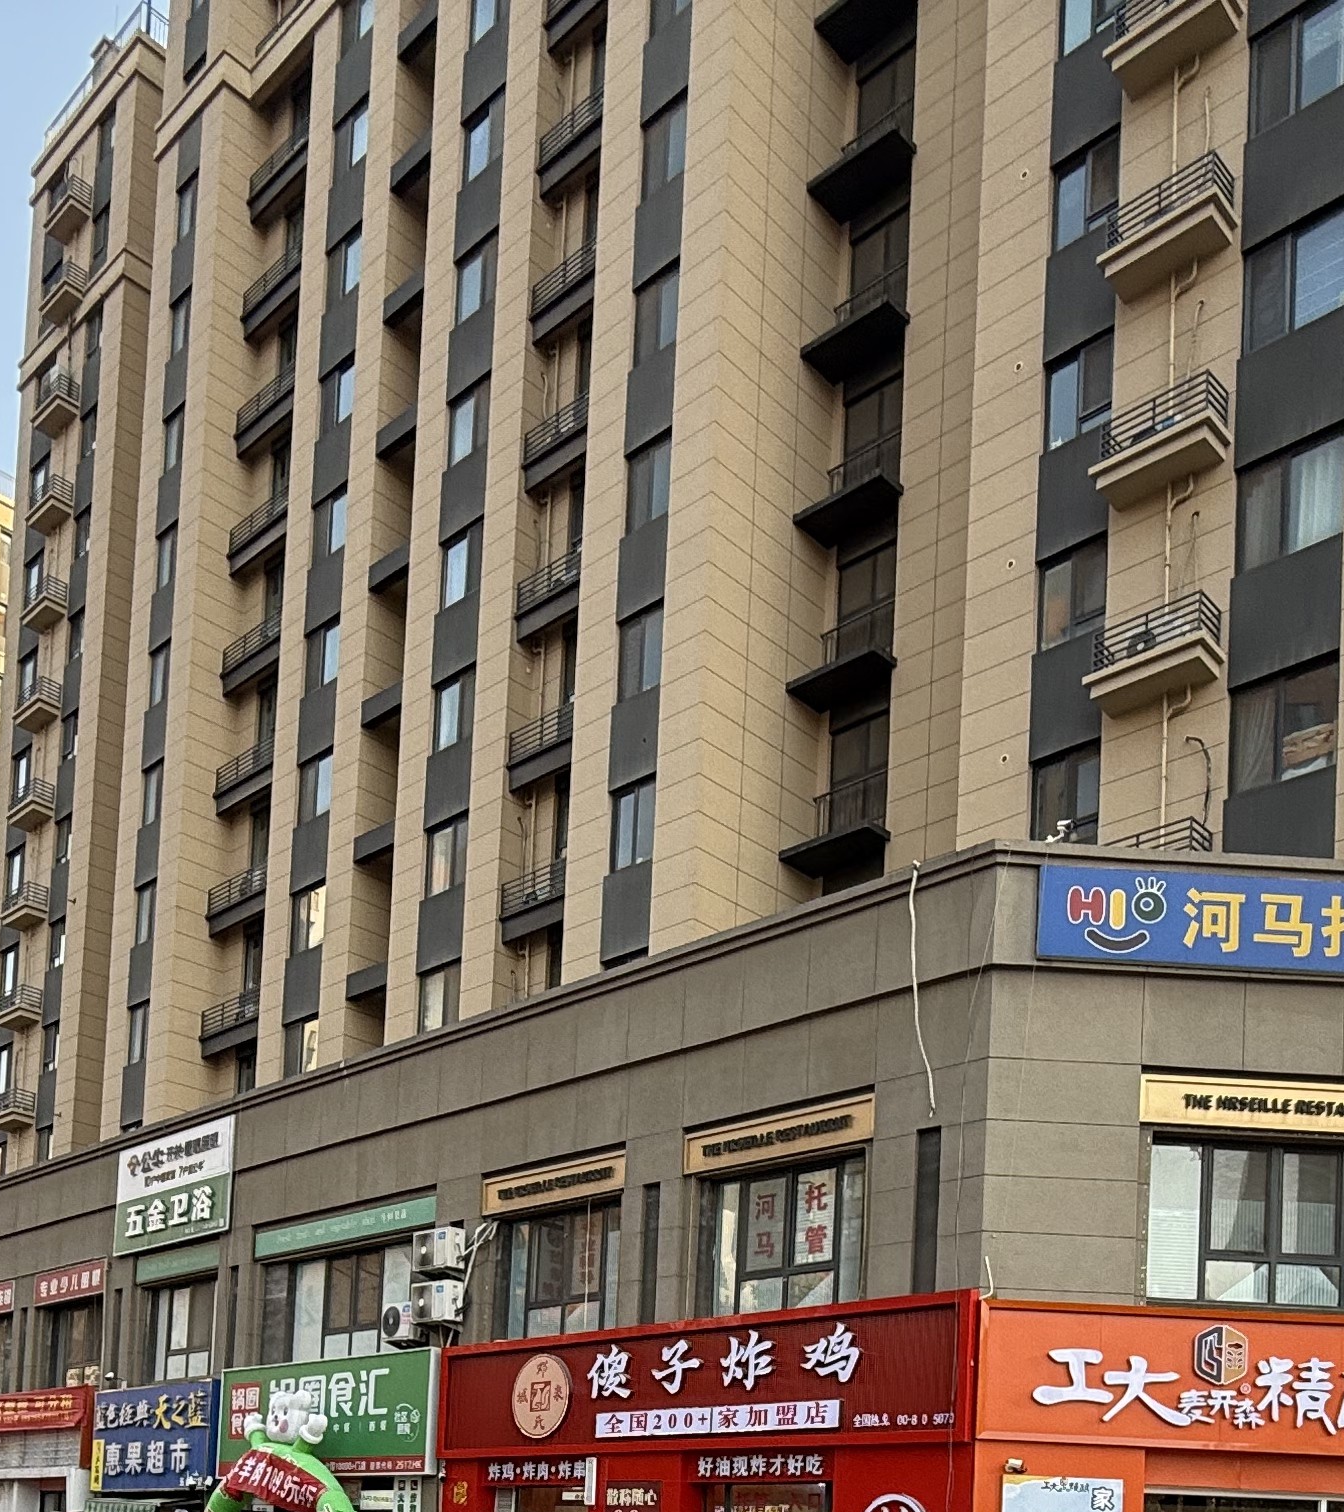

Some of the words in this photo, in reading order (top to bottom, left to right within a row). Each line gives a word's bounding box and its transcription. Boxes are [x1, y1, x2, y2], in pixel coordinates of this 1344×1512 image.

[1184, 1094, 1213, 1110] THE
[125, 1185, 213, 1237] 五金卫浴
[754, 1192, 776, 1258] 河马
[805, 1182, 829, 1255] 托管
[586, 1322, 861, 1399] 傻子炸鸡
[1033, 1347, 1192, 1427] 工大
[604, 1402, 828, 1434] 全国200+家加盟店
[1179, 1388, 1266, 1430] 麦开森
[104, 1438, 190, 1476] 惠果超市
[698, 1454, 824, 1477] 好油现炸才好吃
[606, 1488, 657, 1506] 散称随心
